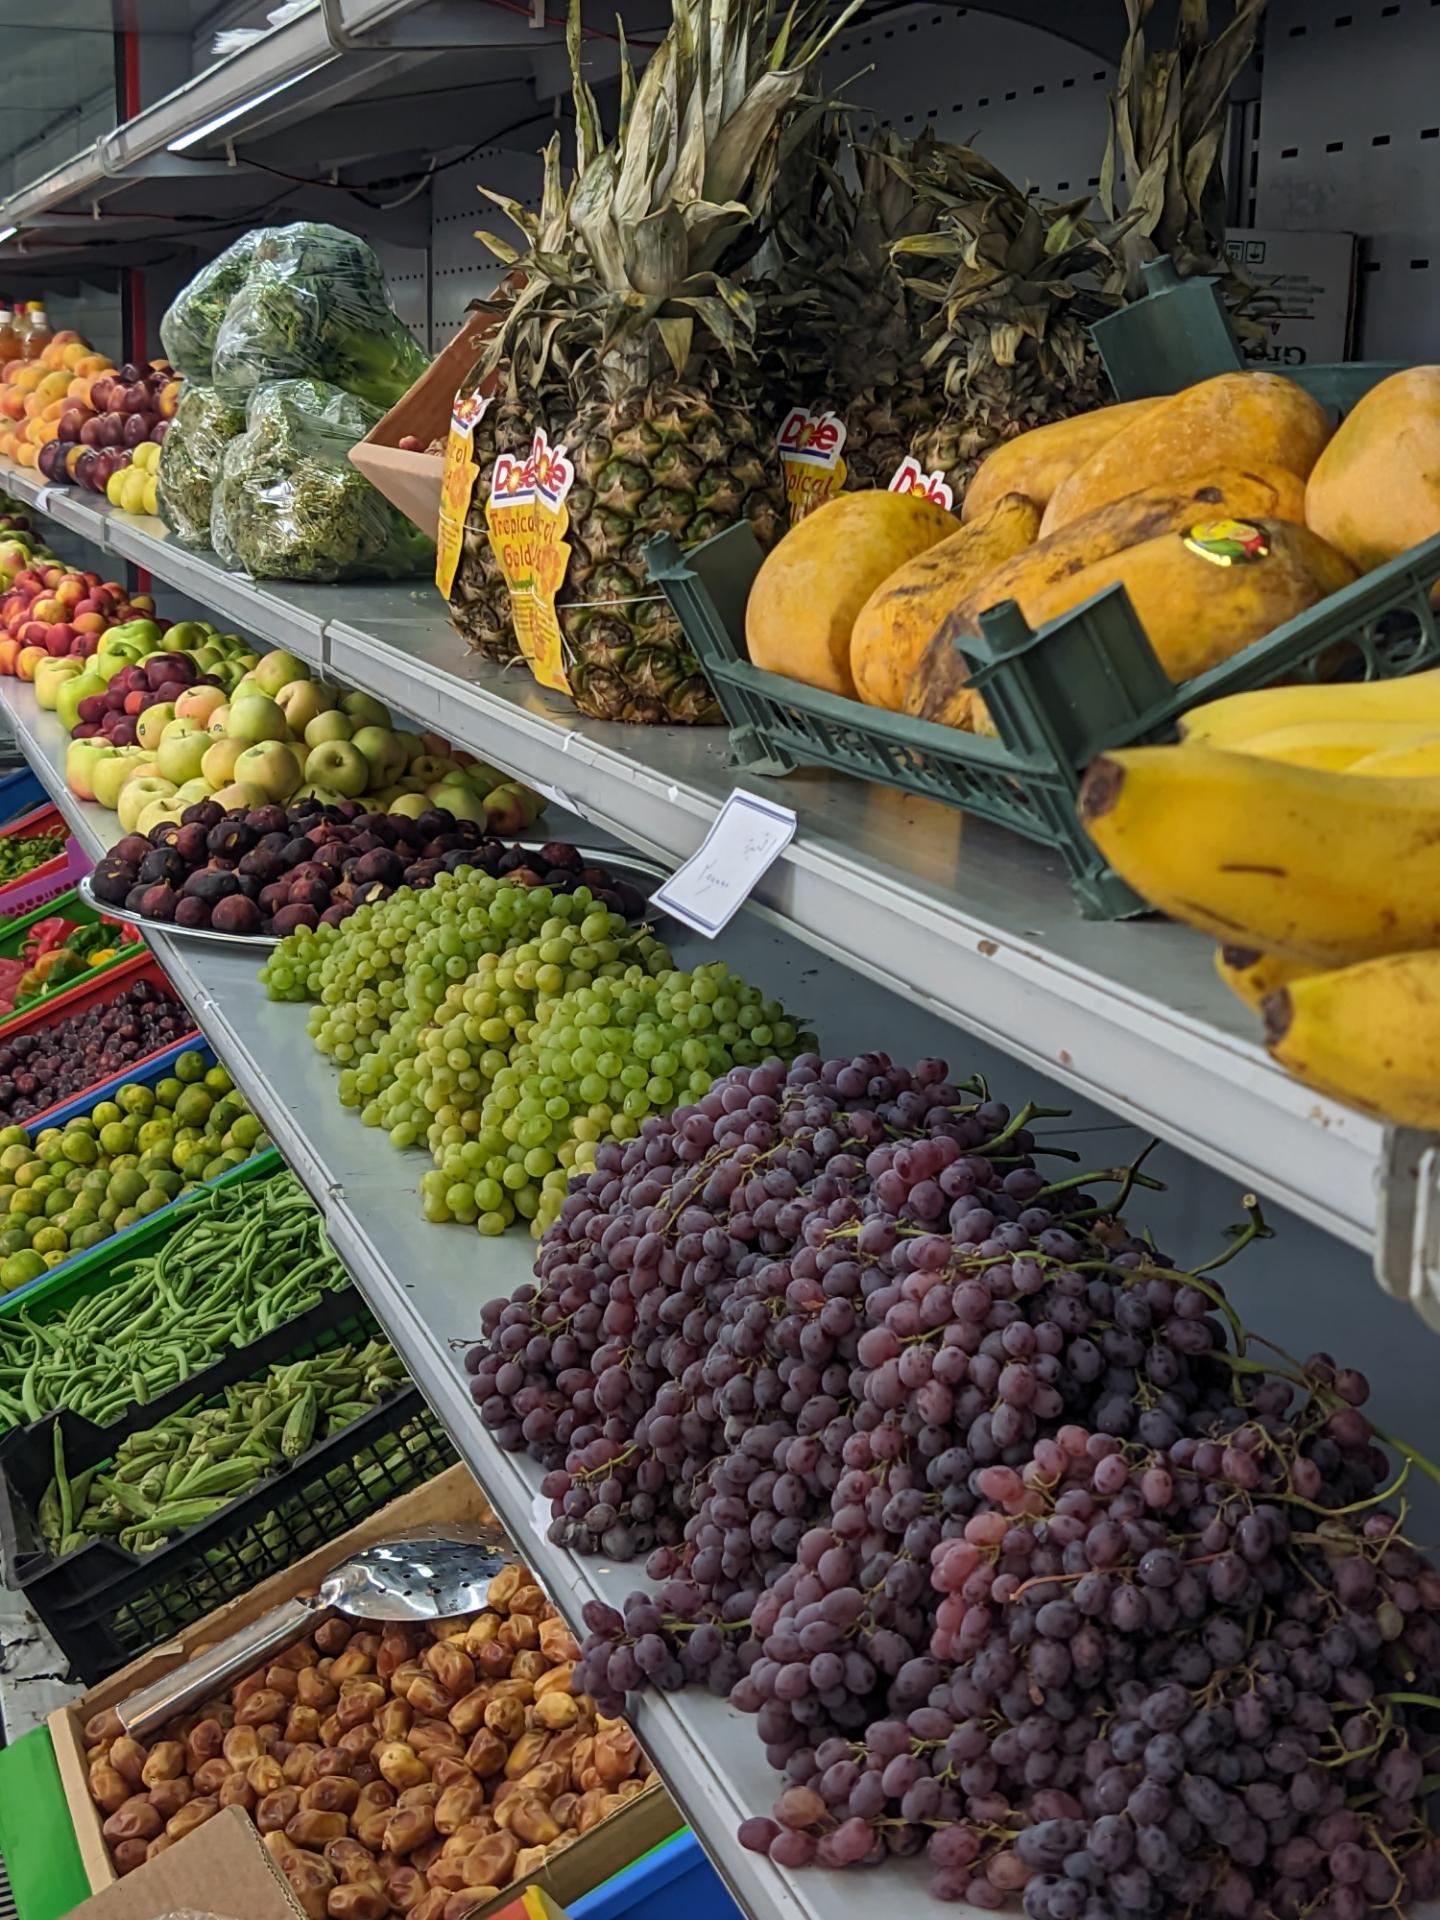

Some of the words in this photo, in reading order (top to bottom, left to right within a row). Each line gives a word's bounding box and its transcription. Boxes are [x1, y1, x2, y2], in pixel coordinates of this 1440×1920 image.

[781, 413, 839, 450] Dole
[490, 511, 535, 539] Tropica
[503, 543, 533, 568] Gold
